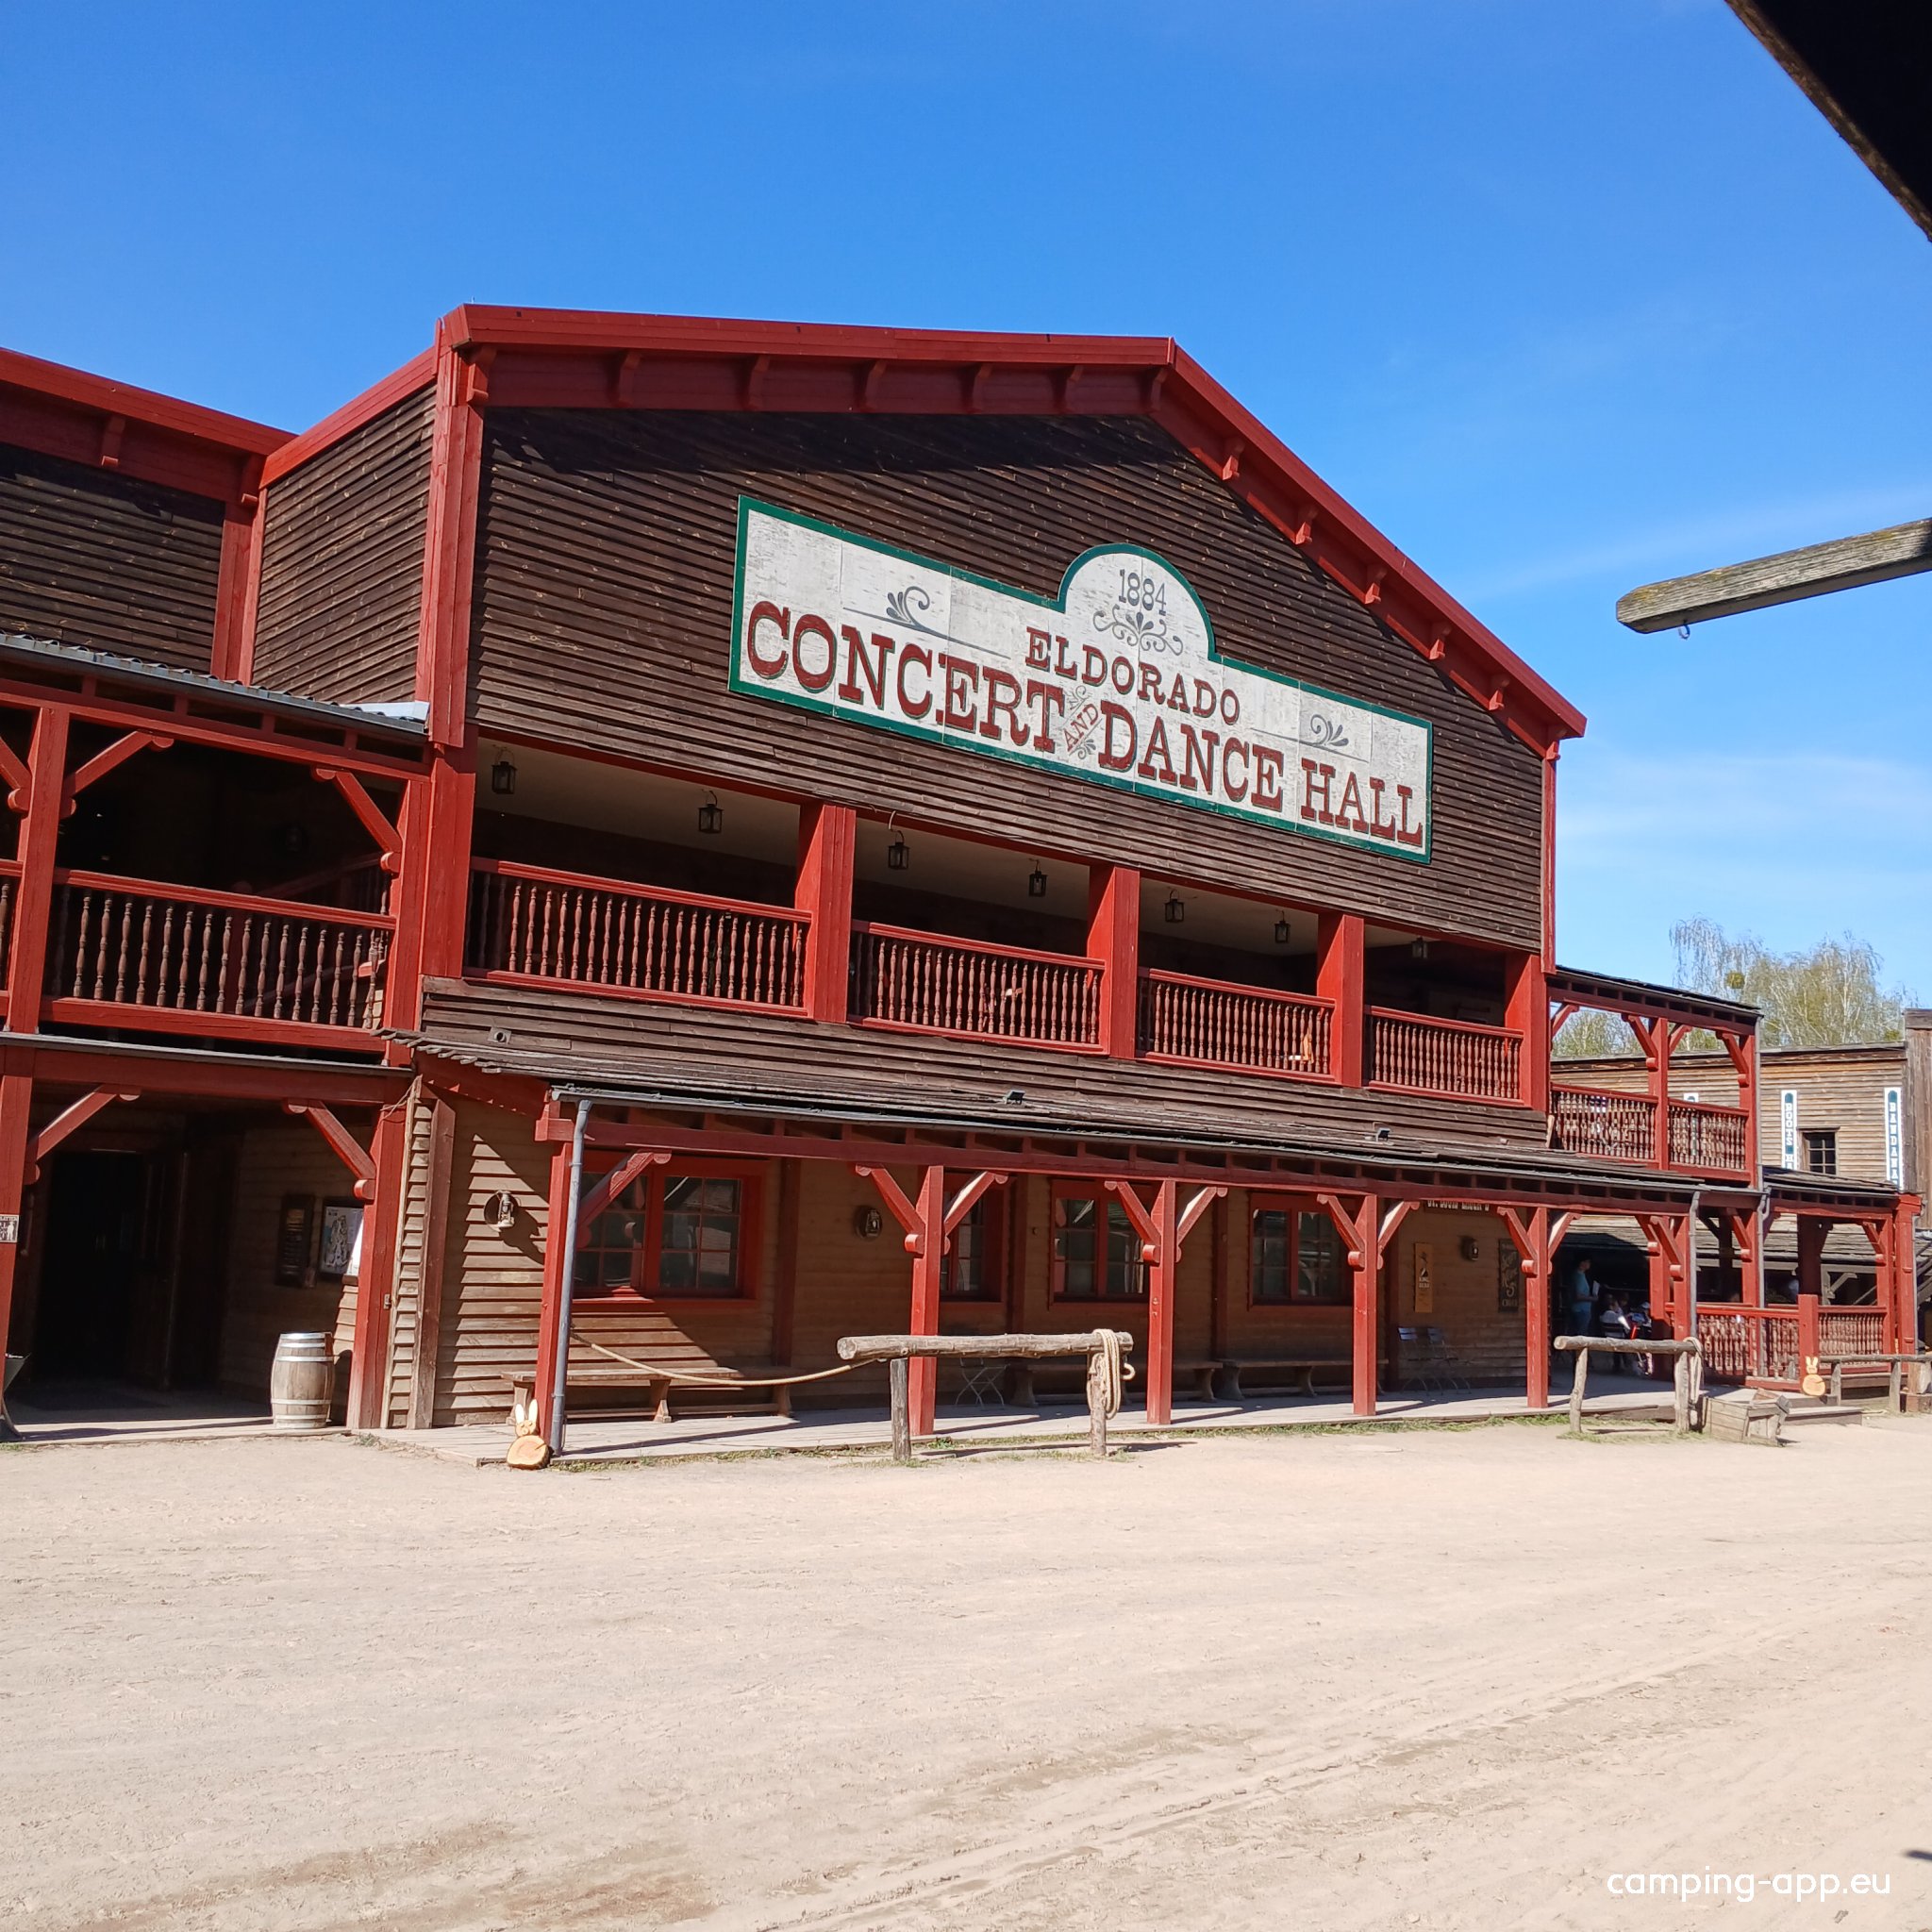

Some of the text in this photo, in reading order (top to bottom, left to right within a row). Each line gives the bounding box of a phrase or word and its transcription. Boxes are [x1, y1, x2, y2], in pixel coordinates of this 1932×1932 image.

[1119, 569, 1167, 616] 1884
[1025, 626, 1241, 725] ELDORADO
[747, 600, 1423, 847] CONCERT AND DANCE HALL
[1785, 1102, 1793, 1145] BOOTS
